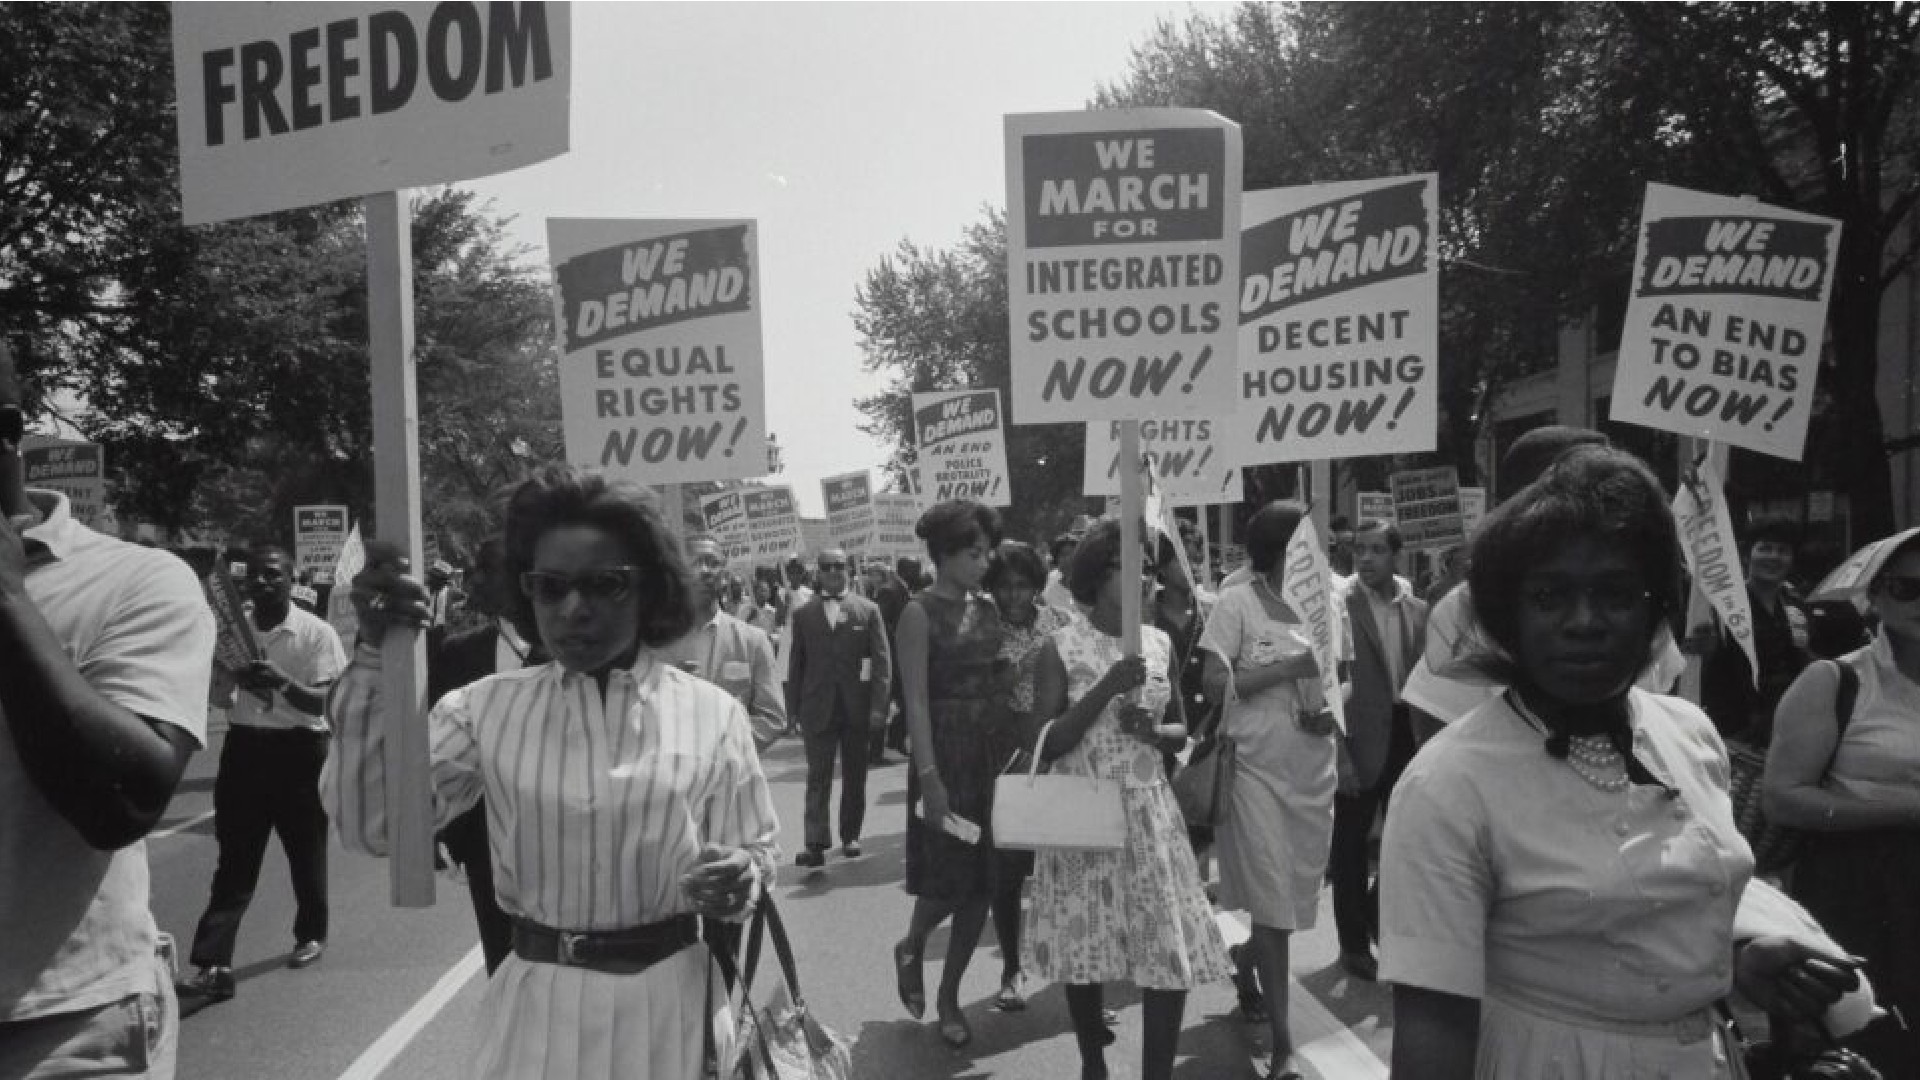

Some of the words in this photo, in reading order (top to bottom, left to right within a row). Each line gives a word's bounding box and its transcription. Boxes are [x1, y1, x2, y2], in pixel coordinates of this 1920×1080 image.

[203, 0, 553, 146] FREEDOM
[1094, 139, 1155, 170] WE
[1038, 173, 1209, 216] MARCH
[1093, 219, 1158, 238] FOR
[1289, 201, 1363, 254] WE
[1704, 220, 1775, 251] WE
[621, 239, 688, 285] WE
[1026, 253, 1223, 294] INTEGRATED
[1240, 225, 1420, 312] DEMAND
[1651, 255, 1820, 289] DEMAND
[576, 266, 744, 339] DEMAND
[1028, 302, 1220, 342] SCHOOLS
[1258, 310, 1409, 353] DECENT
[1650, 303, 1711, 337] AN
[1724, 315, 1806, 356] END
[596, 345, 734, 378] EQUAL
[1042, 345, 1212, 402] NOW!
[1243, 355, 1424, 398] HOUSING
[1650, 337, 1700, 370] TO
[1711, 349, 1798, 392] BIAS
[596, 383, 741, 418] RIGHTS
[942, 397, 971, 419] WE
[1256, 387, 1415, 443] NOW!
[1644, 376, 1794, 432] NOW!
[600, 416, 747, 466] NOW!
[925, 408, 993, 441] DEMAND
[1110, 420, 1210, 441] RGHTS
[937, 475, 1001, 501] NOW!
